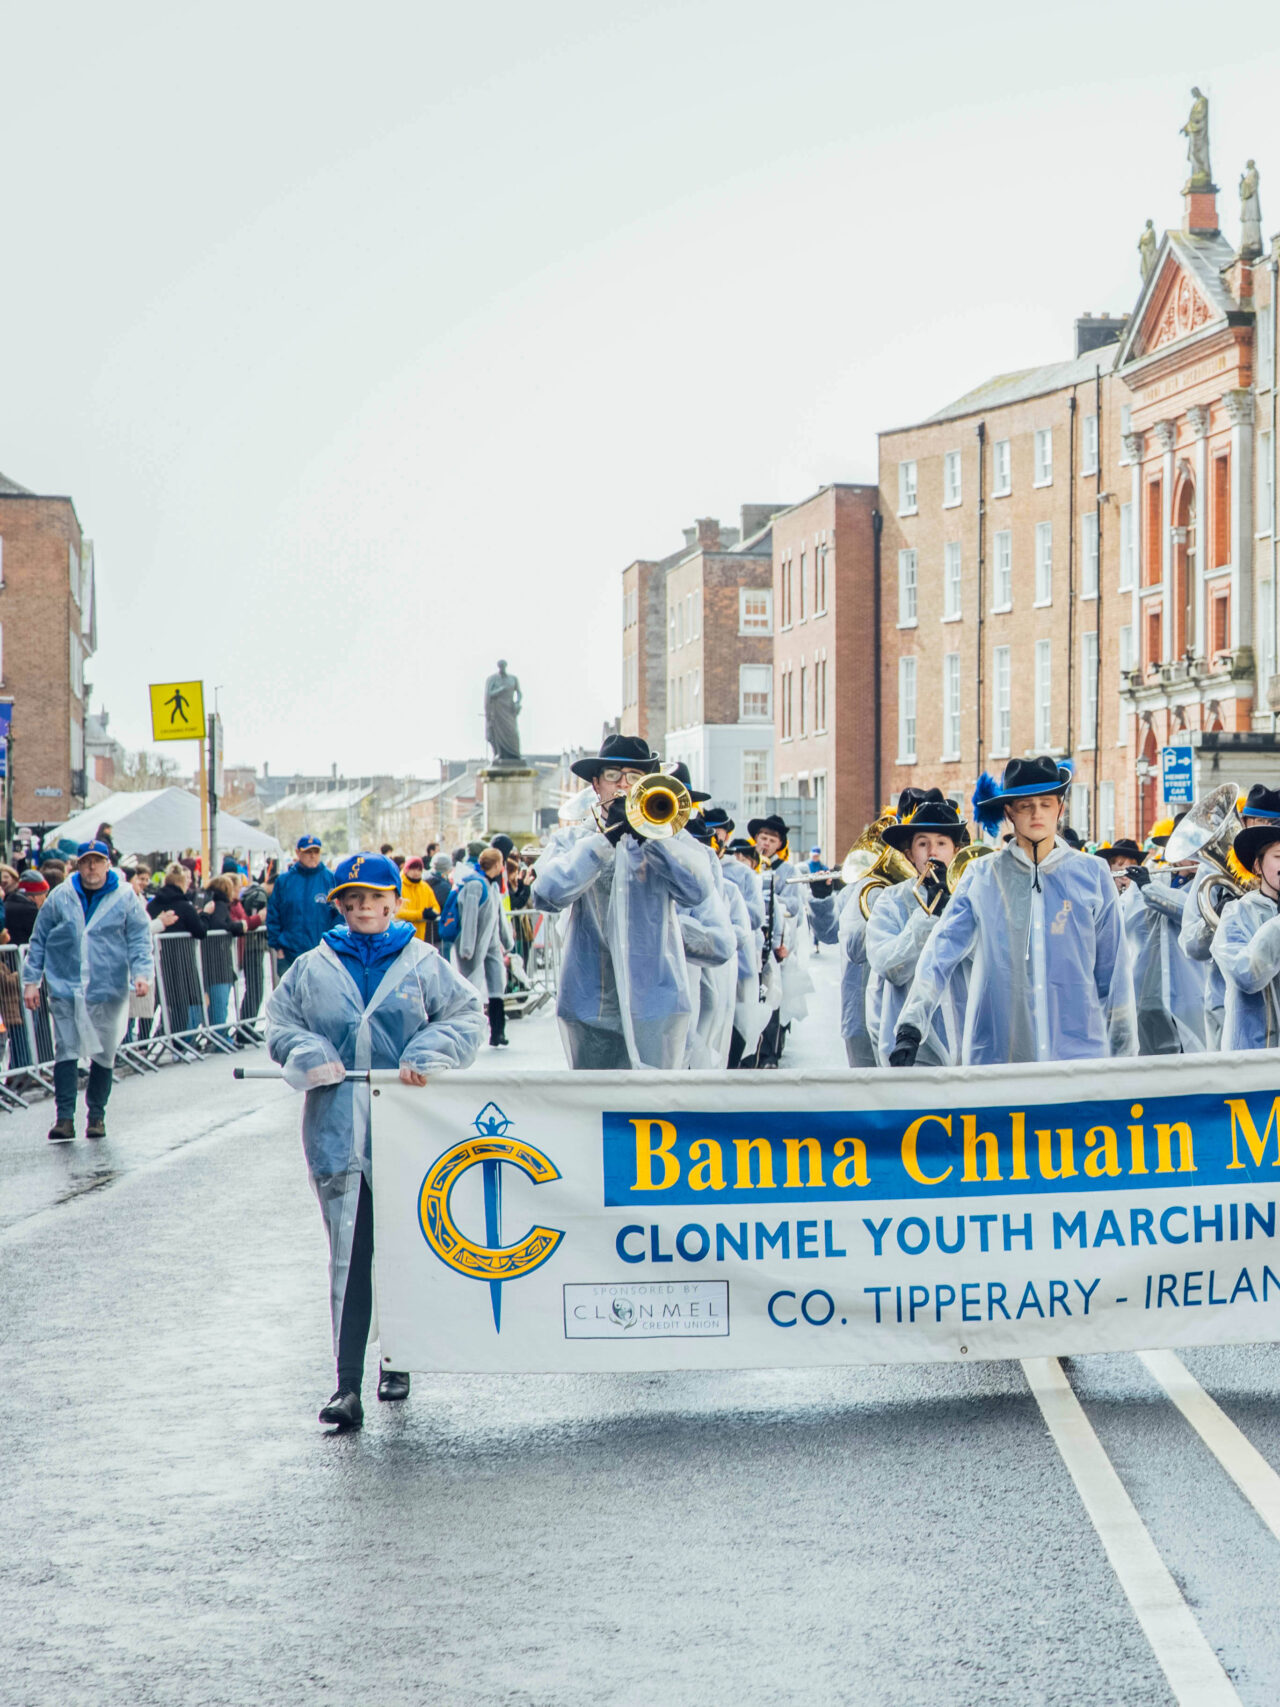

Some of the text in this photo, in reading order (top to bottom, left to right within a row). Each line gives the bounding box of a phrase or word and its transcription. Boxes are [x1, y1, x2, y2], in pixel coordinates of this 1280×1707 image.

[1164, 754, 1176, 772] P
[1165, 780, 1191, 788] STREET
[629, 1118, 872, 1192] Banna
[901, 1103, 1198, 1185] Chluain
[615, 1219, 847, 1264] CLONMEL
[863, 1213, 1033, 1257] YOUTH
[592, 1284, 700, 1297] SPONSORED BY
[767, 1289, 848, 1328] CO.
[864, 1278, 1101, 1324] TIPPERARY
[642, 1319, 720, 1330] CREDIT UNION
